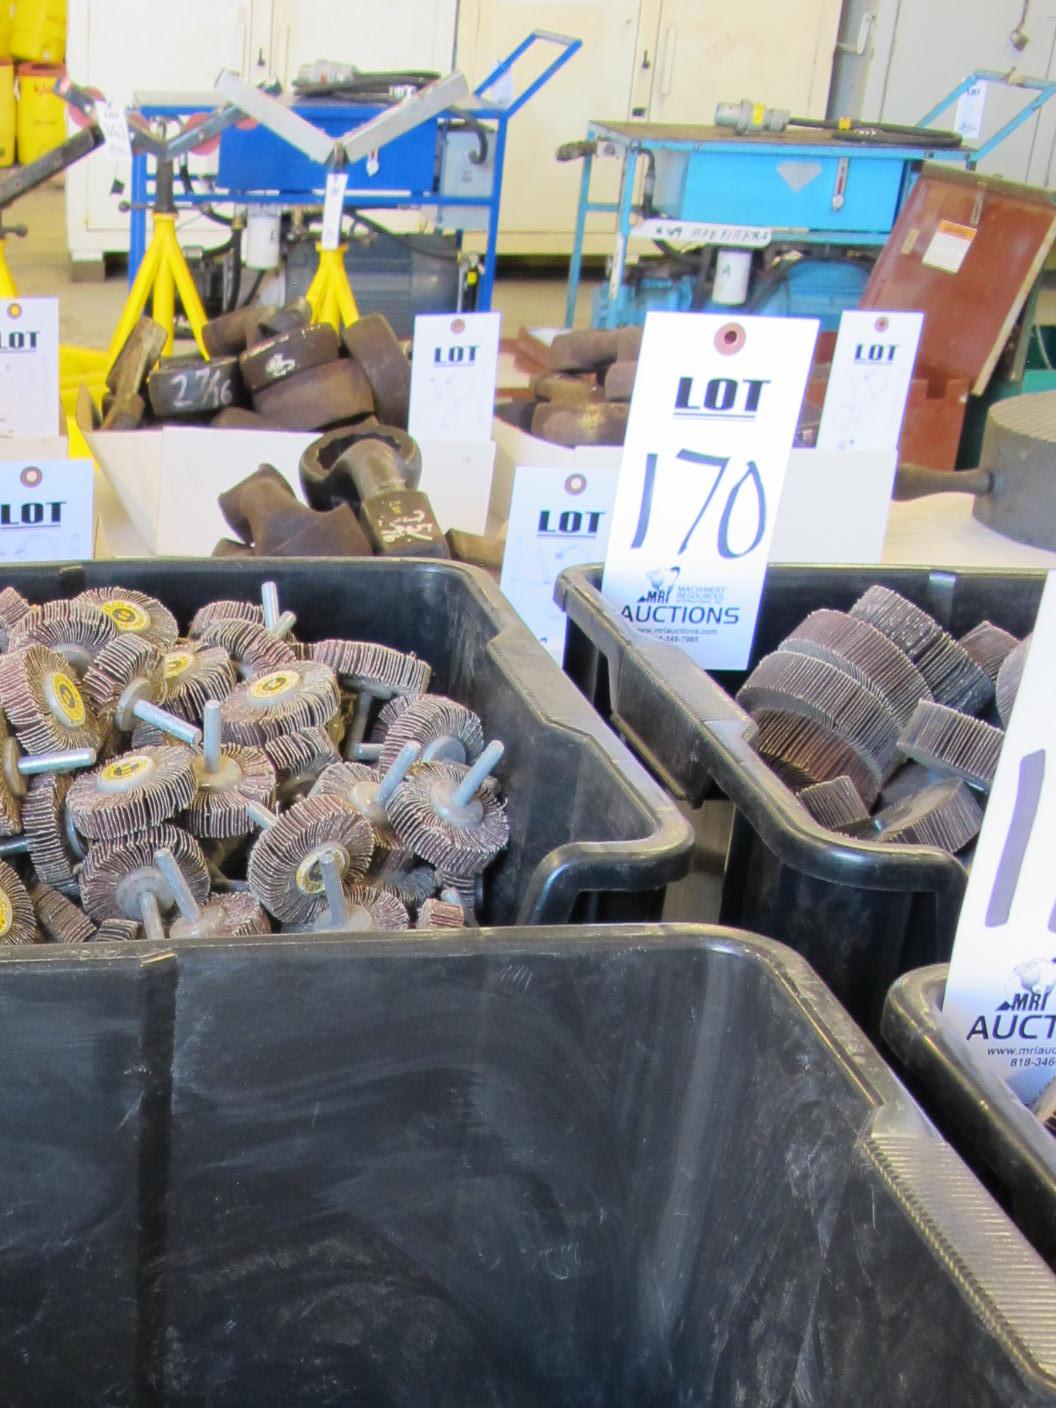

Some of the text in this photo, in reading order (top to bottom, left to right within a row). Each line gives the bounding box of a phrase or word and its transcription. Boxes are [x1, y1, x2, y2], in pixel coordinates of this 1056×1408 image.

[434, 345, 480, 363] LOT
[855, 344, 900, 361] LOT
[674, 377, 772, 412] LOT
[0, 501, 67, 525] LOT
[631, 448, 766, 559] 170
[538, 510, 606, 533] LOT
[621, 604, 740, 625] AUCTIONS
[1011, 992, 1050, 1011] MRI
